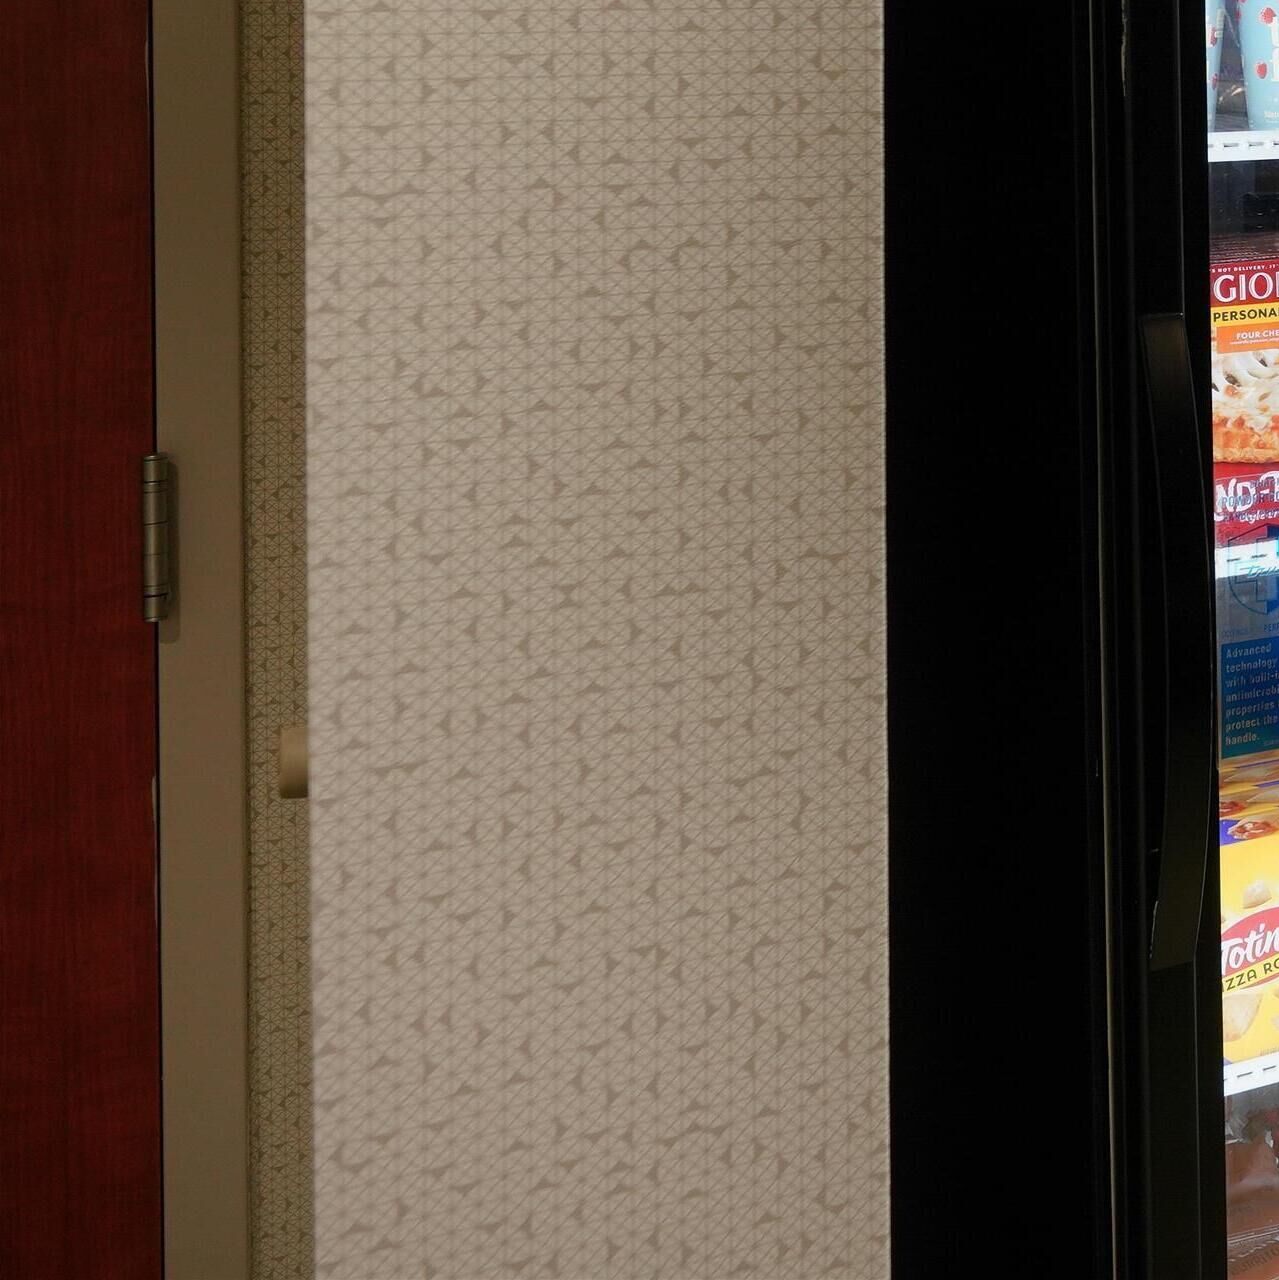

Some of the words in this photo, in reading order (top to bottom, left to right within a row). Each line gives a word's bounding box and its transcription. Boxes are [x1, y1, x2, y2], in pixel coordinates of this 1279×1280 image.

[1236, 330, 1261, 339] FOUR
[1226, 643, 1272, 658] Advanced
[1226, 657, 1278, 673] technology
[1225, 701, 1275, 718] properties
[1225, 718, 1260, 733] protect
